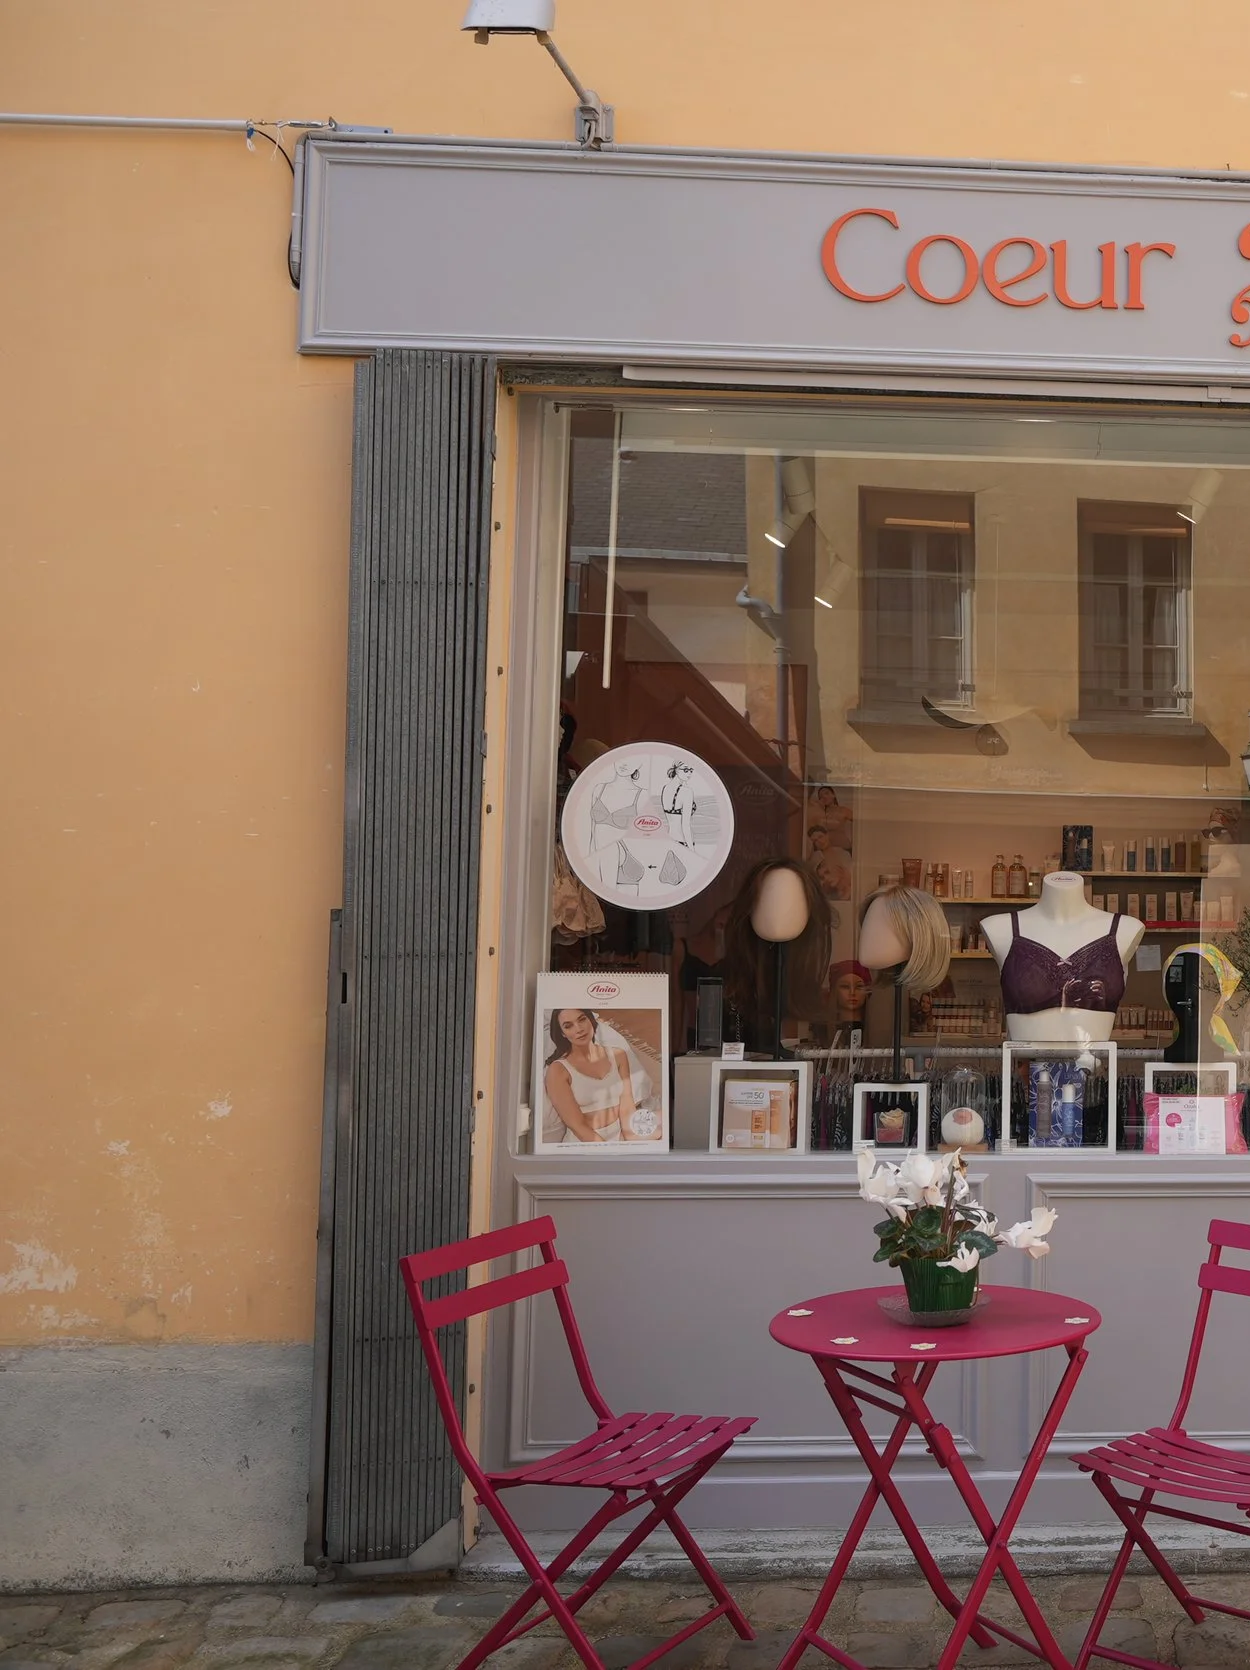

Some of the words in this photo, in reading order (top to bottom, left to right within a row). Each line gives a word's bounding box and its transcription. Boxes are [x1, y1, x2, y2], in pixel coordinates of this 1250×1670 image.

[821, 207, 1177, 311] Coeur
[636, 818, 659, 826] Anita
[589, 985, 617, 994] Anita
[753, 1091, 765, 1100] 50
